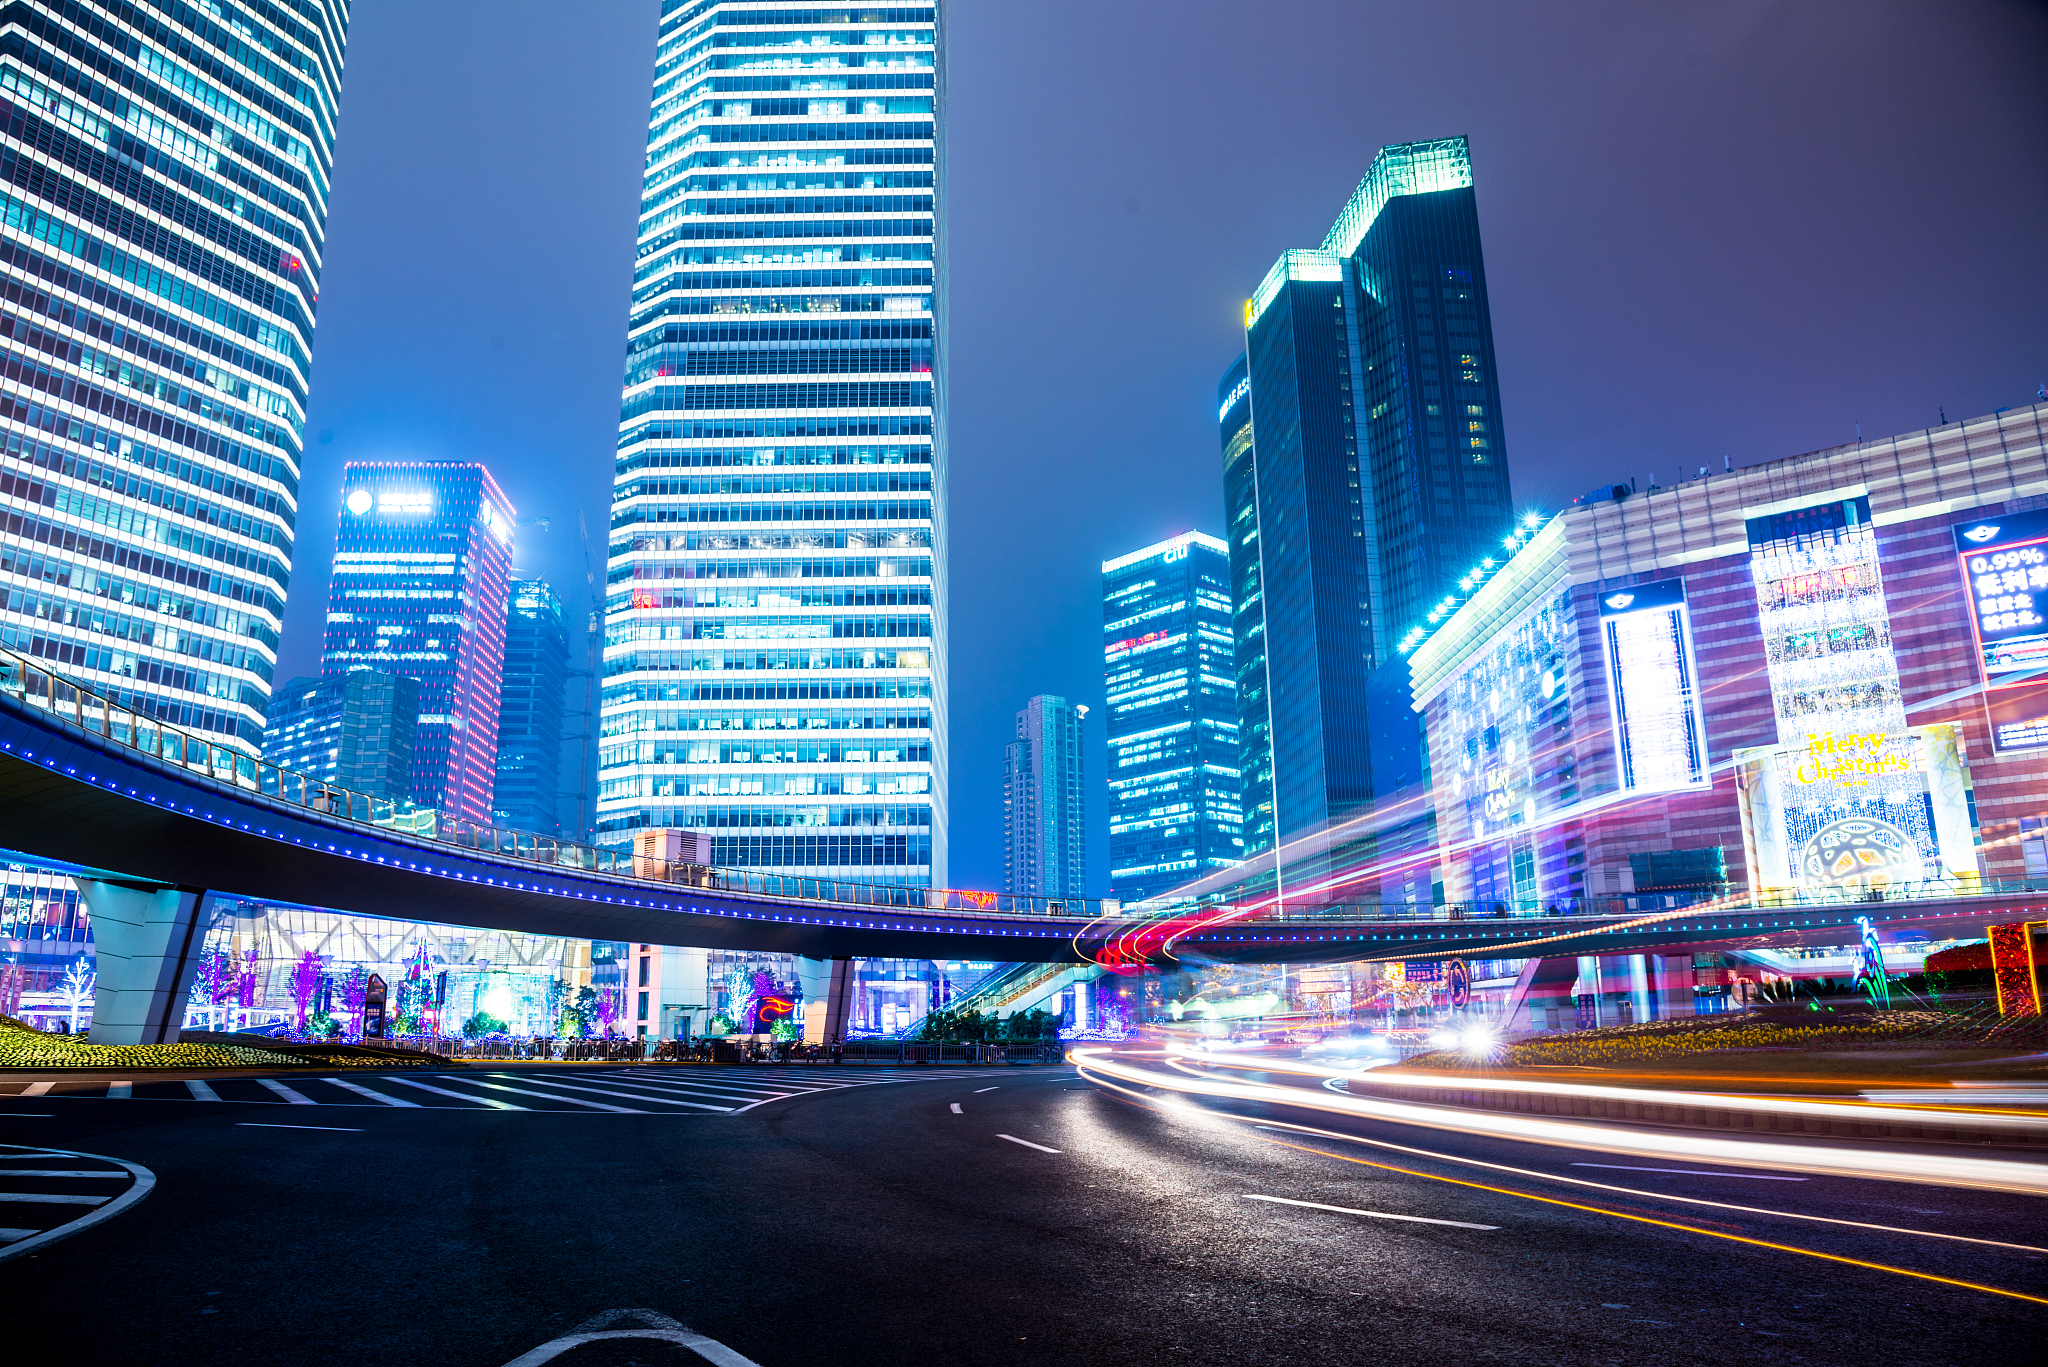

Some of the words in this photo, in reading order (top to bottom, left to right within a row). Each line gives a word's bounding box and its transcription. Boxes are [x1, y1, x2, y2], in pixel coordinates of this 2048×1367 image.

[1972, 548, 2044, 573] 0.99%
[1806, 731, 1886, 756] Merry
[1797, 754, 1909, 784] Christmas
